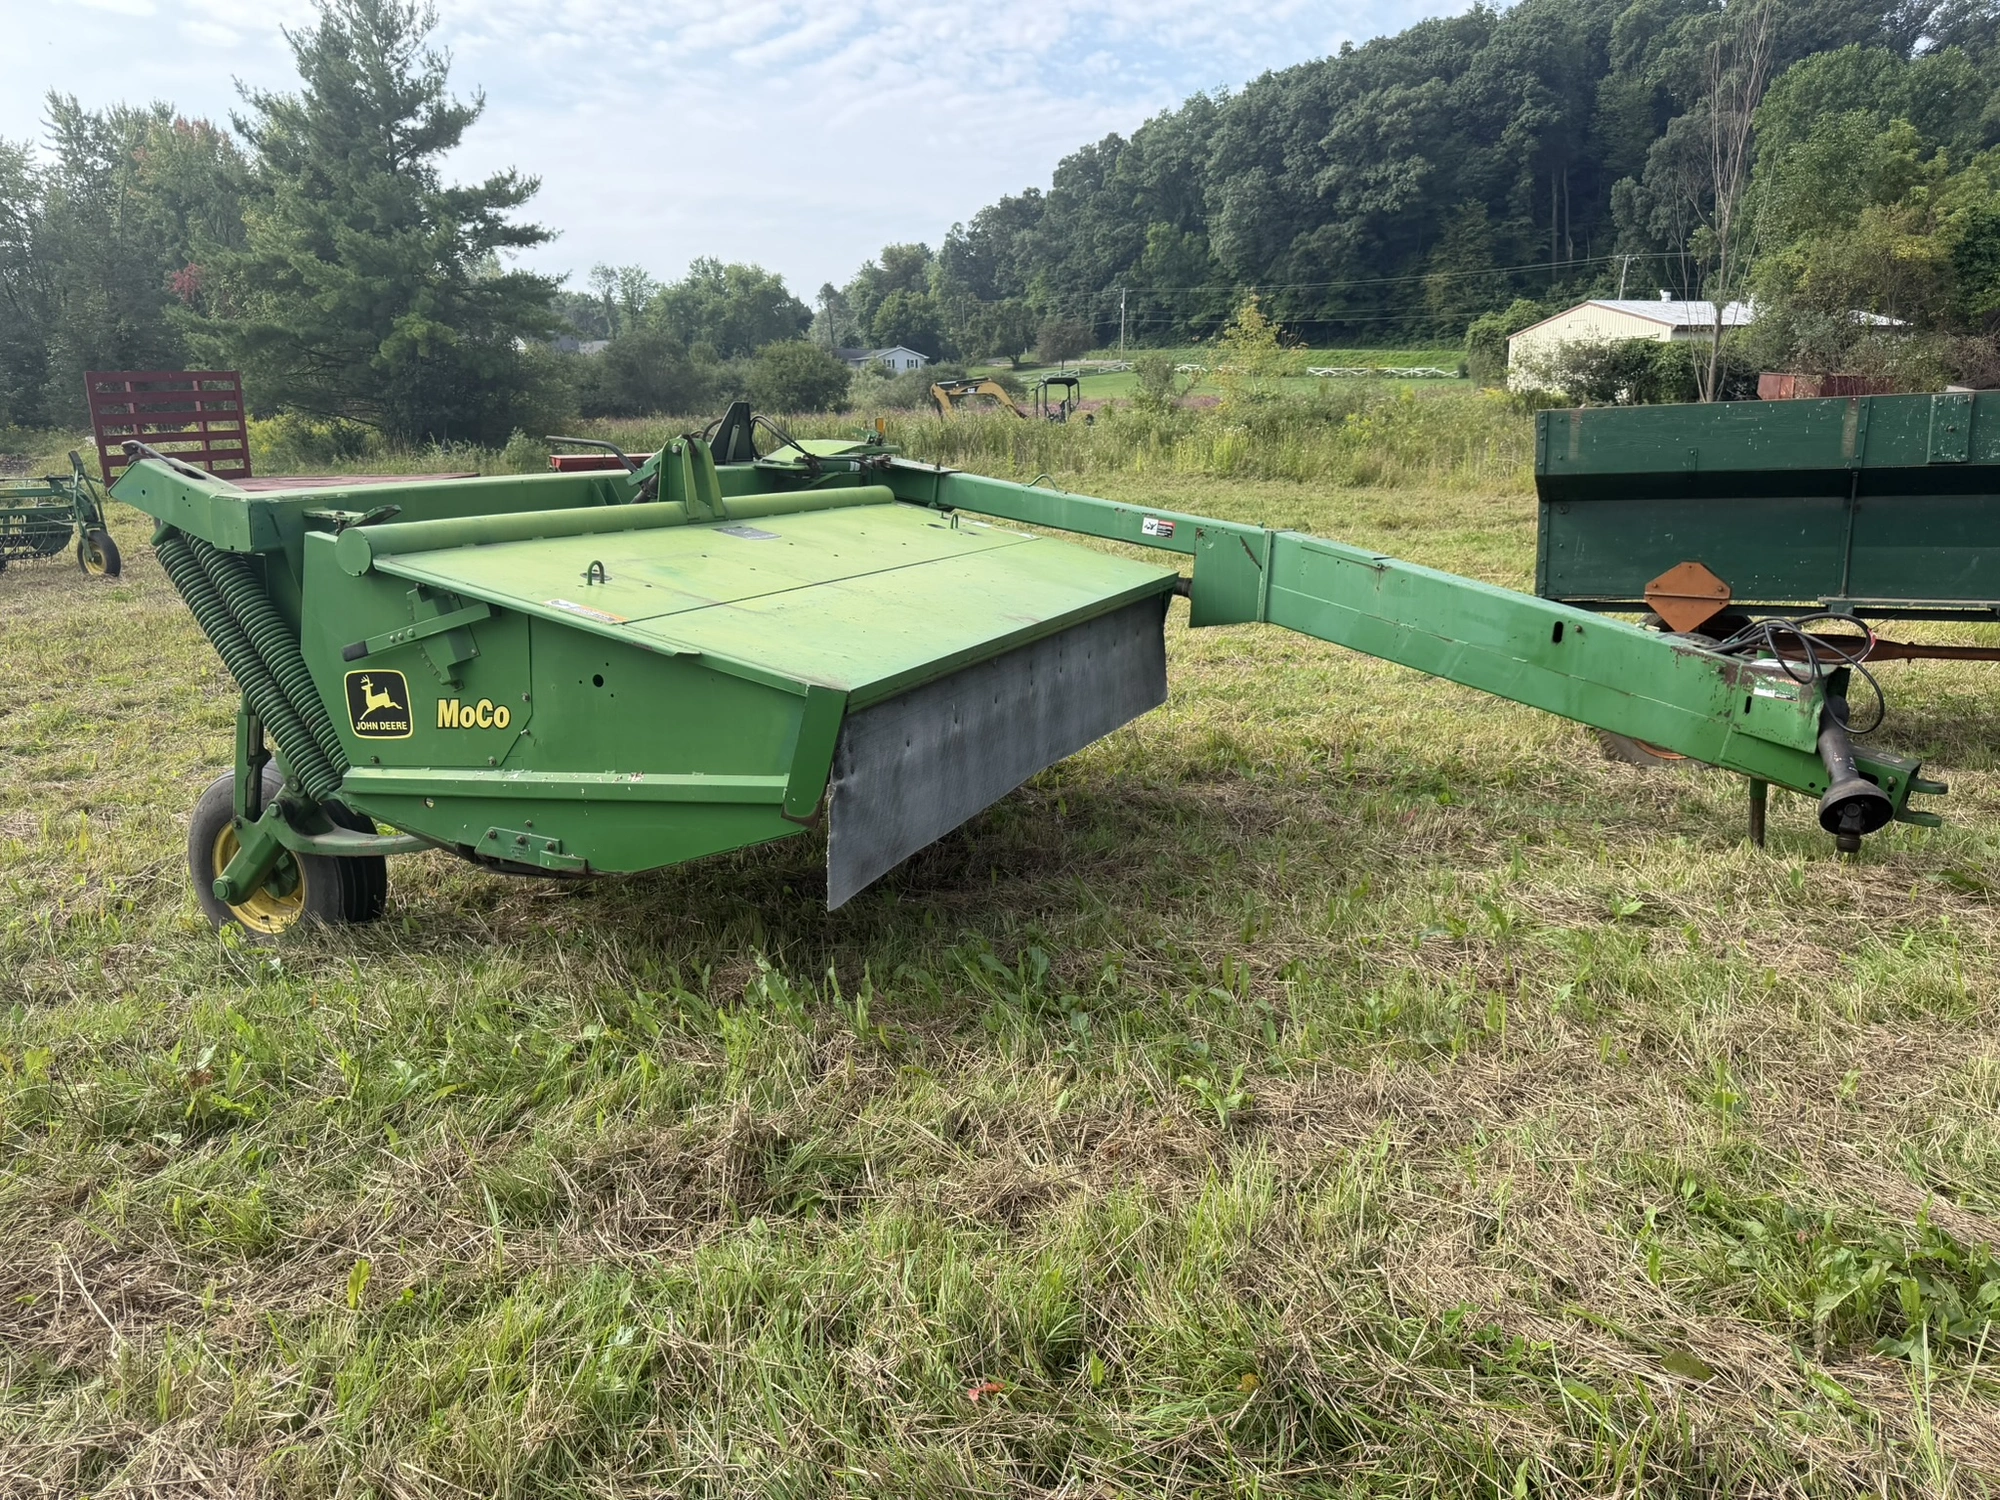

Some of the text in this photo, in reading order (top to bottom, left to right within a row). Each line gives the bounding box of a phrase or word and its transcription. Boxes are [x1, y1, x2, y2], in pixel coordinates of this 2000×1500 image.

[437, 698, 510, 729] MoCo
[356, 721, 408, 730] JOHN DEERE
